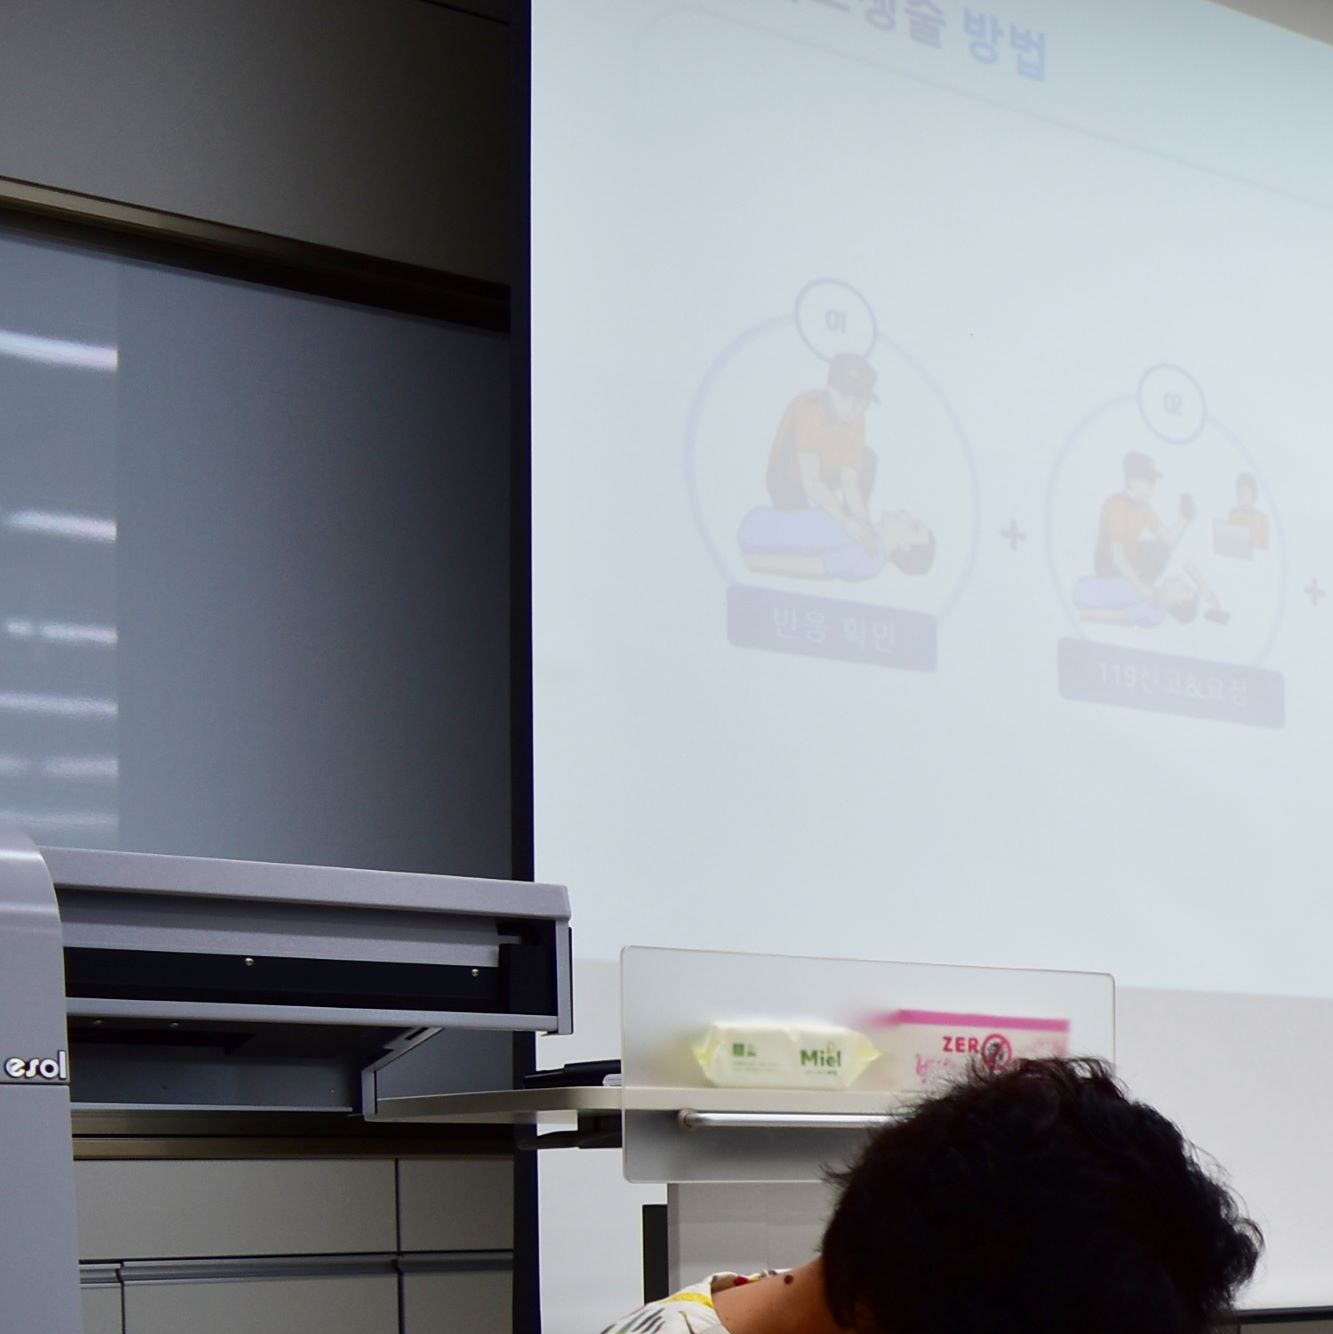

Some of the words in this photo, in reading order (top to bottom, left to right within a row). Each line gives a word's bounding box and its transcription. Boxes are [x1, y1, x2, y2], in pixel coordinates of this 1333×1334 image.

[962, 5, 1046, 82] 방법
[824, 309, 848, 335] 01
[4, 1050, 67, 1080] esol
[801, 1049, 842, 1067] Miel
